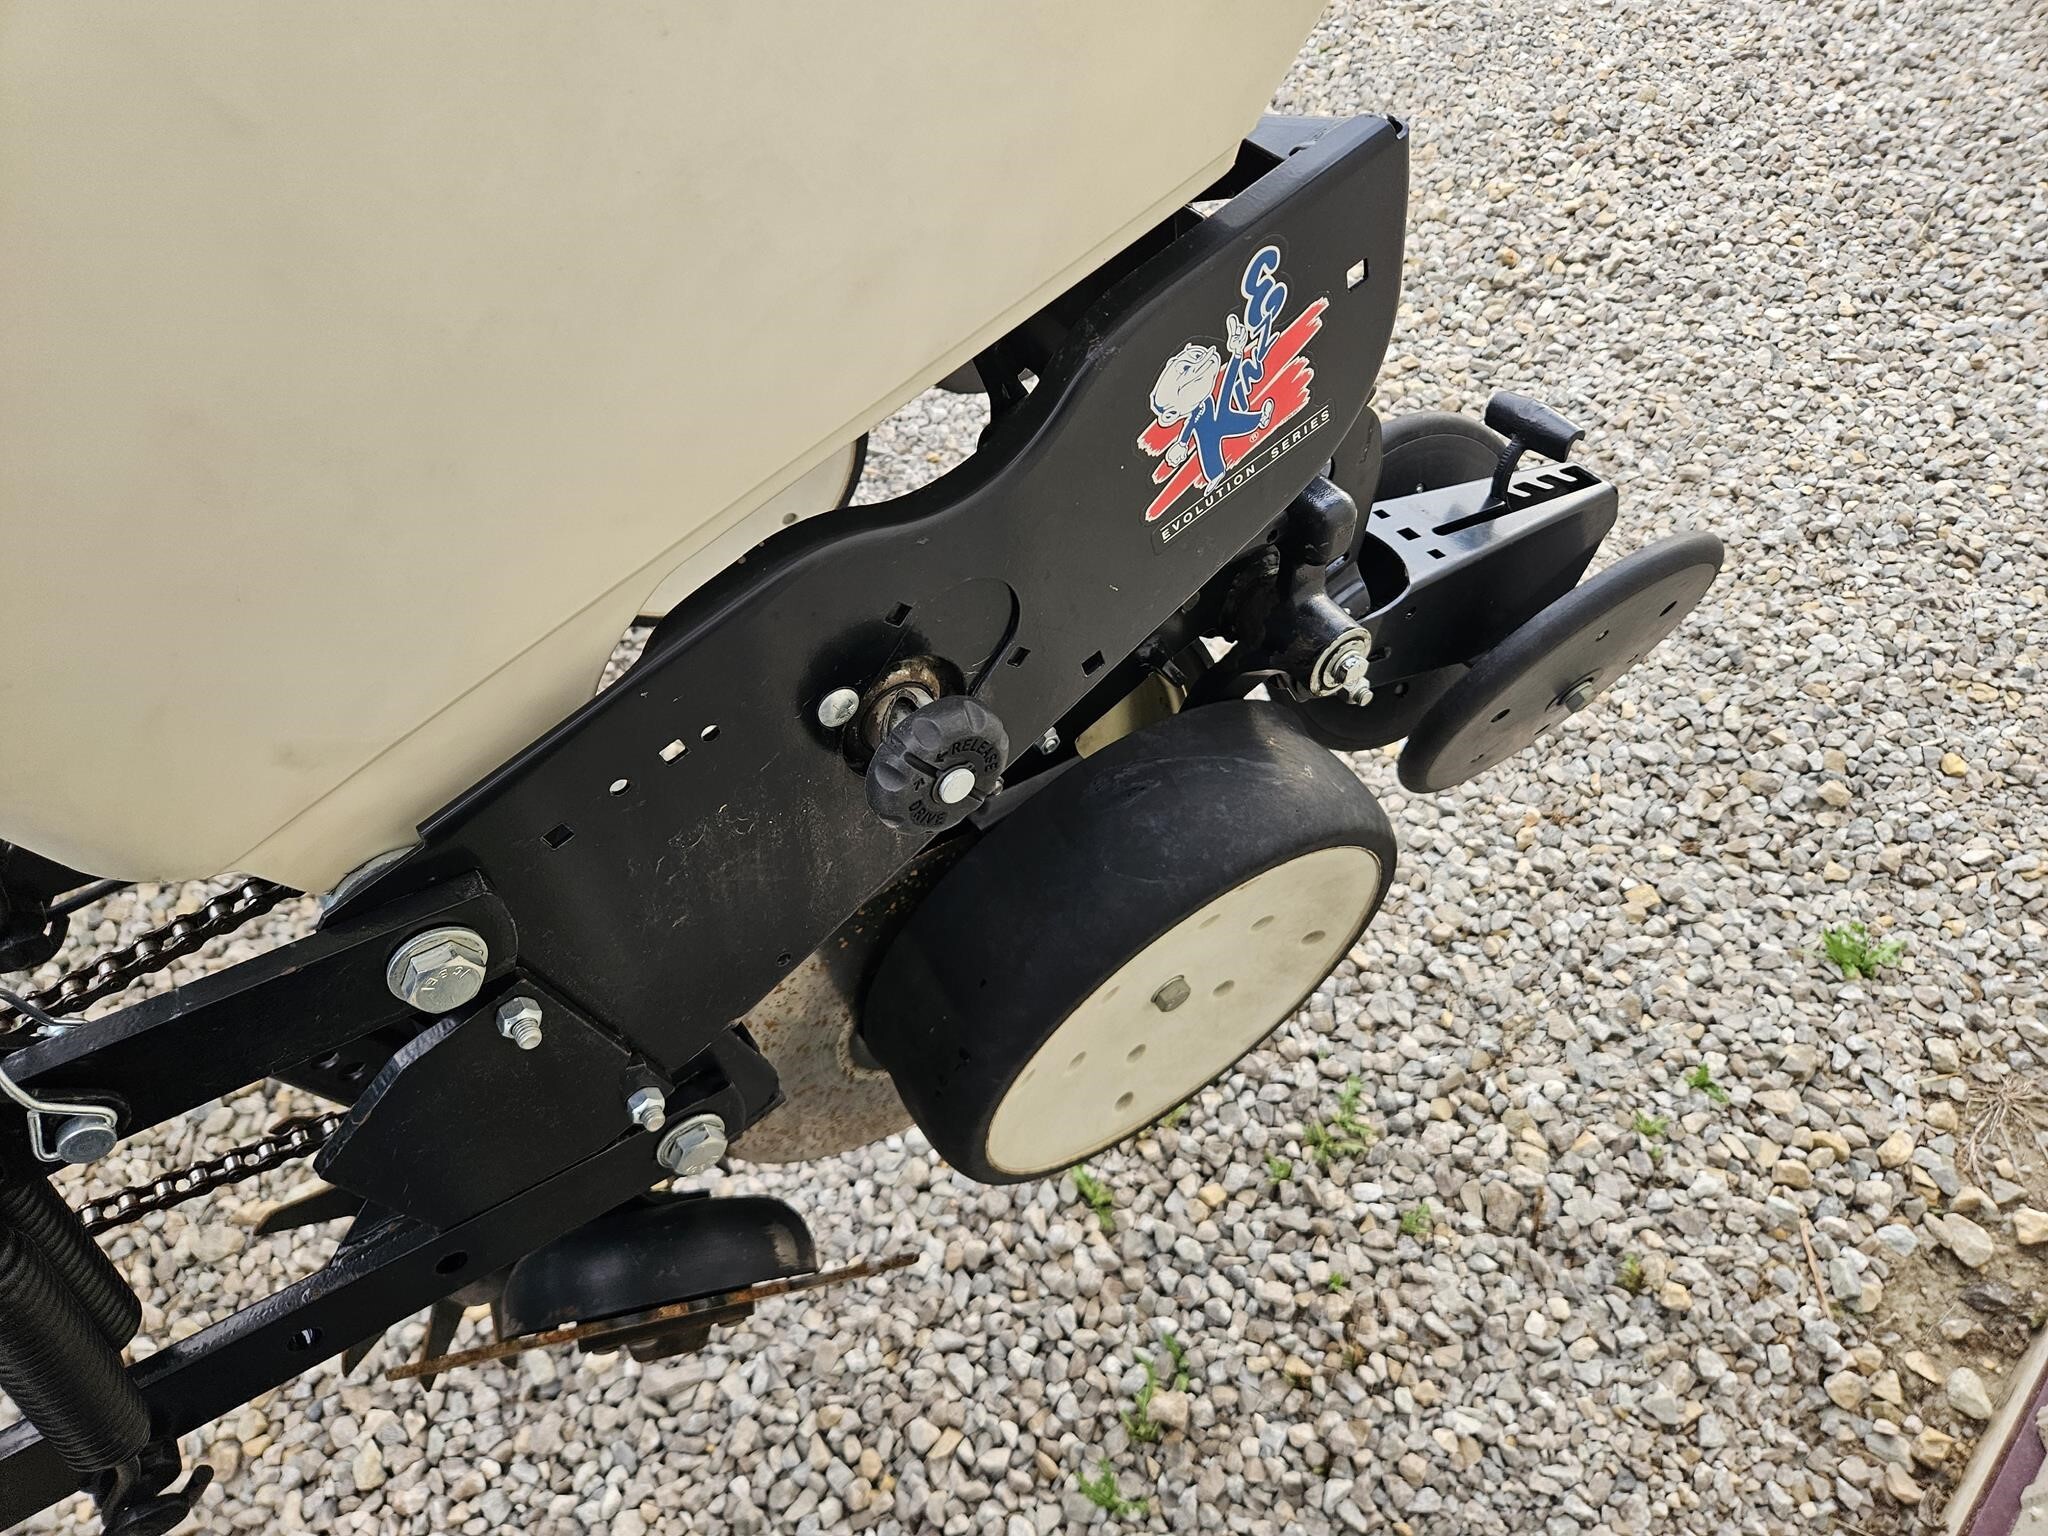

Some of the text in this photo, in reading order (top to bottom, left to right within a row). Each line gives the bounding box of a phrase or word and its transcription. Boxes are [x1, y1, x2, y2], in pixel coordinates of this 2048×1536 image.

[1161, 410, 1330, 541] EVOLUTION SERIES
[951, 739, 998, 772] RELEASE
[909, 800, 944, 825] DRIVE
